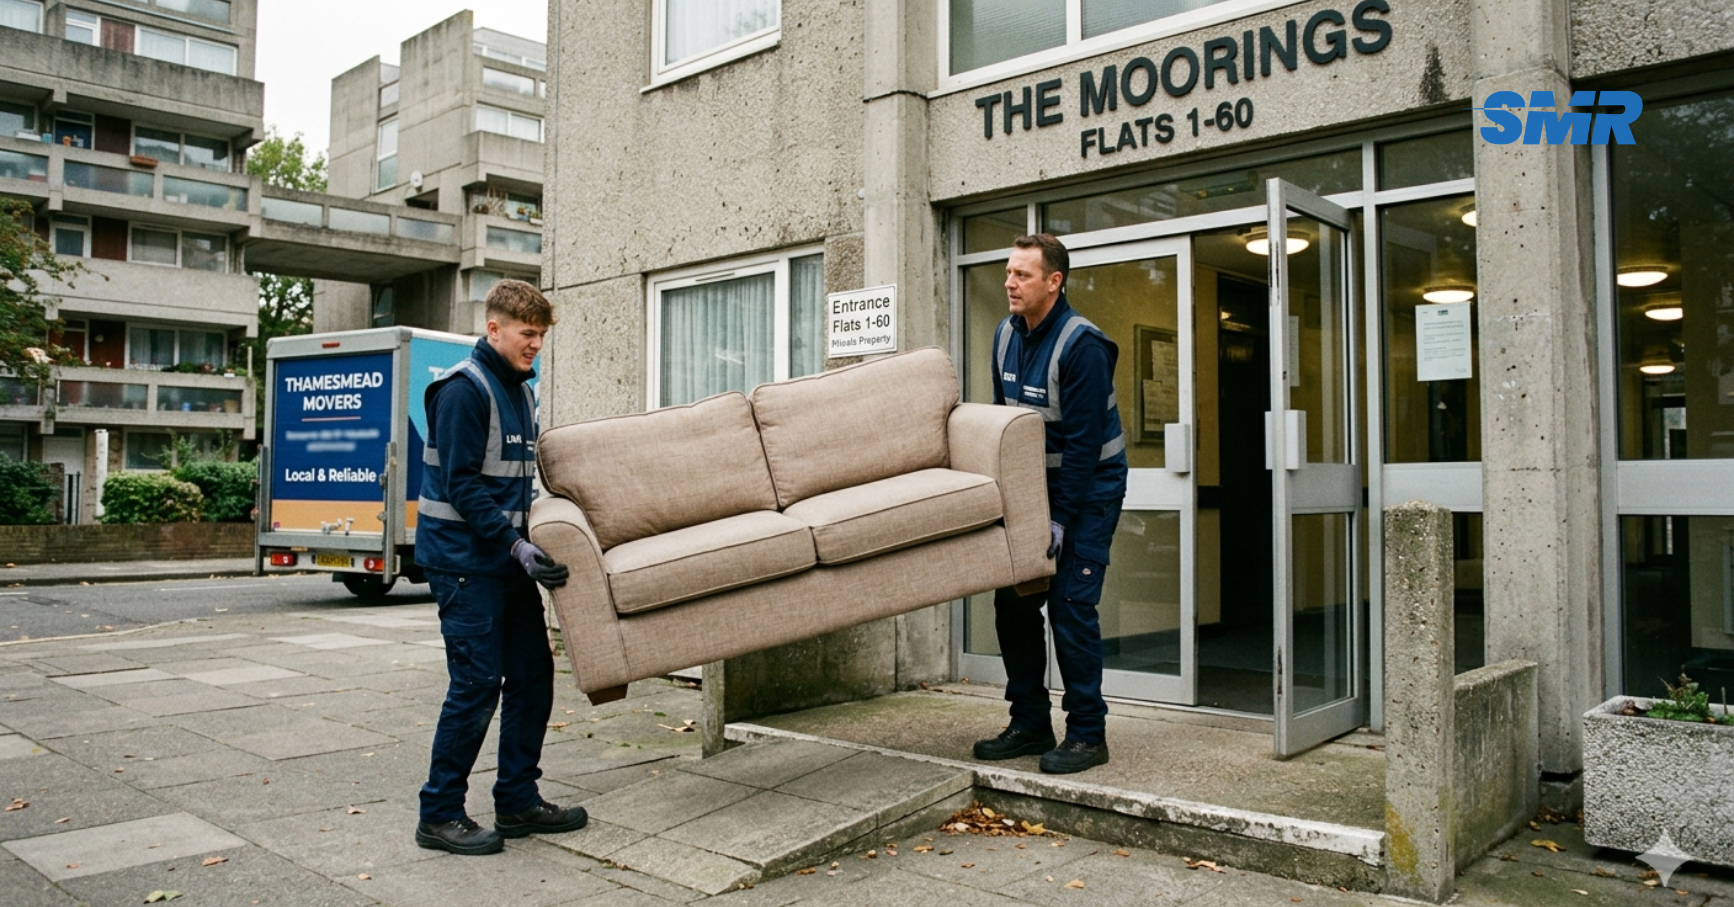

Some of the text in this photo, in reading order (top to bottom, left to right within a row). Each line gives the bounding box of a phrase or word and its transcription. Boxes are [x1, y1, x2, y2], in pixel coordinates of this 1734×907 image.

[975, 0, 1393, 139] THE MOORINGS
[1080, 98, 1254, 158] FLATS 1-60
[833, 296, 890, 314] Entrance
[833, 314, 890, 333] Flats 1-60
[285, 372, 383, 392] THAMESMEAD
[303, 394, 362, 411] MOVERS
[285, 468, 377, 482] Local & Reliable
